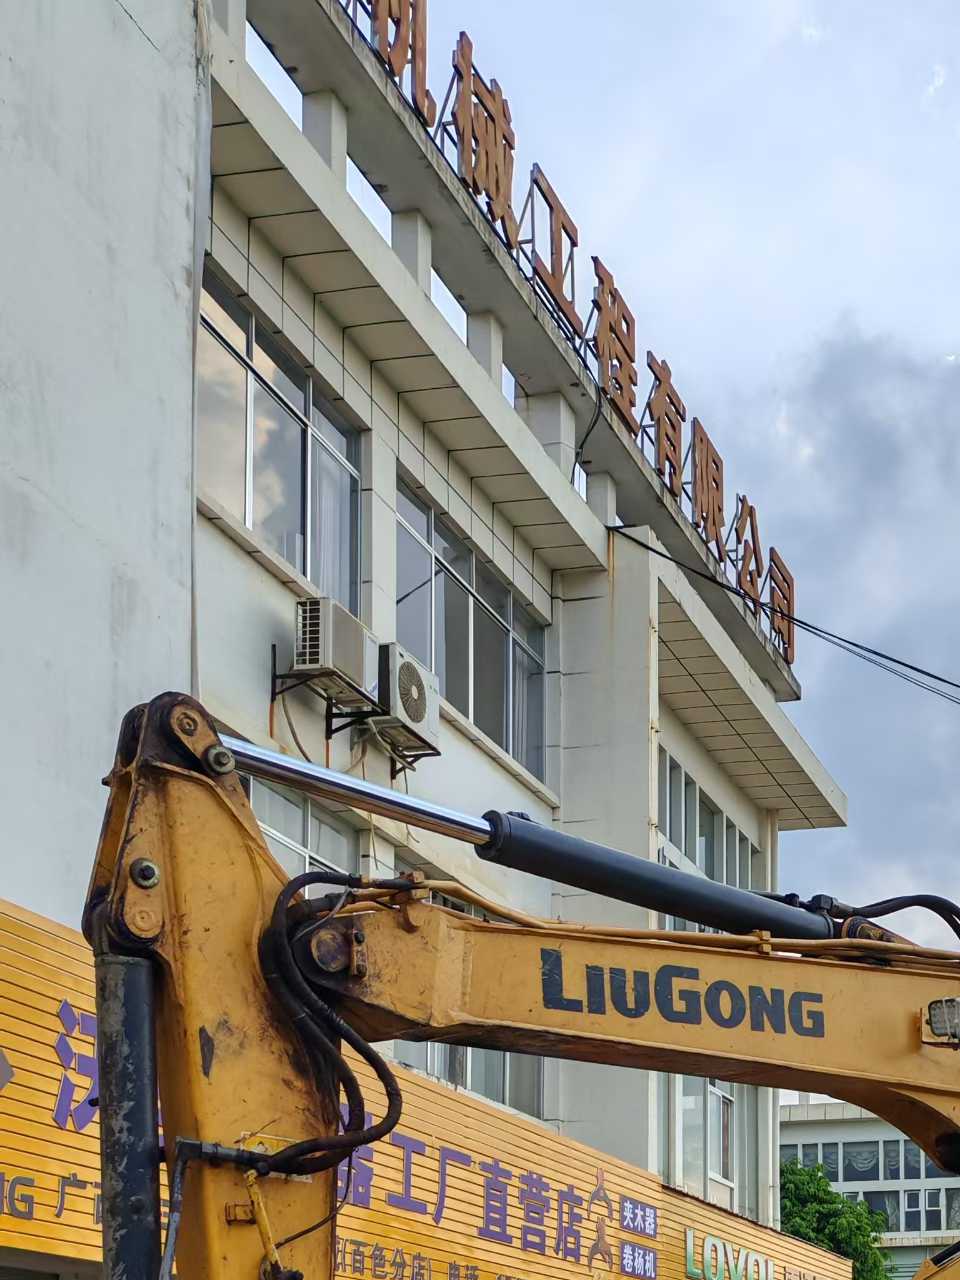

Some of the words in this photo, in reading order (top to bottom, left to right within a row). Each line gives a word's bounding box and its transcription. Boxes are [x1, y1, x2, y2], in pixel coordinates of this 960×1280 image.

[623, 1200, 656, 1236] 夹木器
[622, 1244, 656, 1279] 卷杨机
